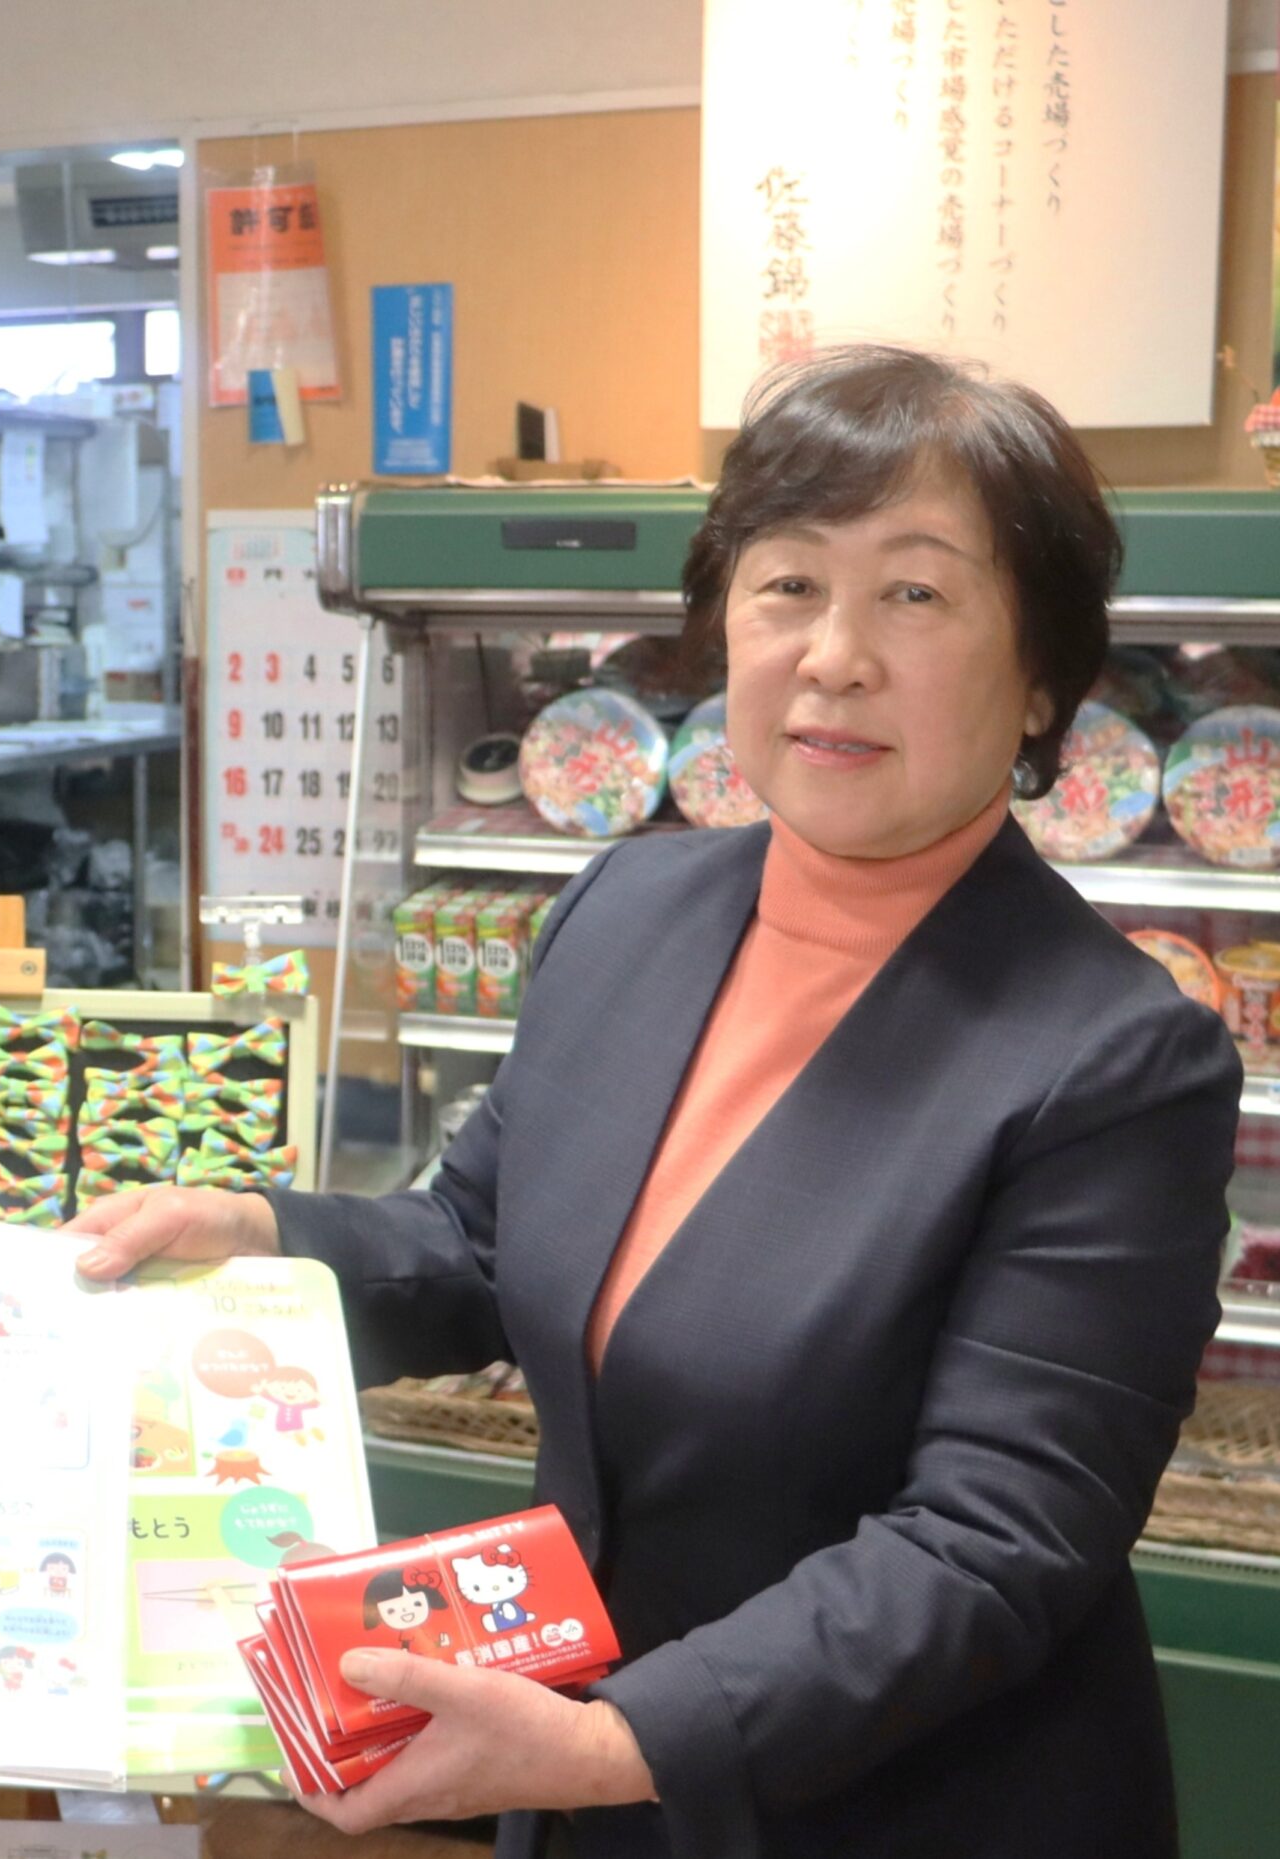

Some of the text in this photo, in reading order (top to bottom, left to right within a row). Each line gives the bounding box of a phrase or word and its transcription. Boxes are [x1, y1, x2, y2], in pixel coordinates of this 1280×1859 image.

[227, 651, 396, 685] 2 3 4 5 6
[227, 709, 243, 739] 9
[261, 711, 285, 740] 10
[299, 713, 322, 742] 11
[375, 713, 400, 744] 13
[223, 766, 247, 797] 16
[260, 768, 284, 797] 17
[298, 770, 322, 799] 18
[258, 824, 285, 855] 24
[295, 827, 322, 855] 25
[130, 1516, 191, 1540] もとう
